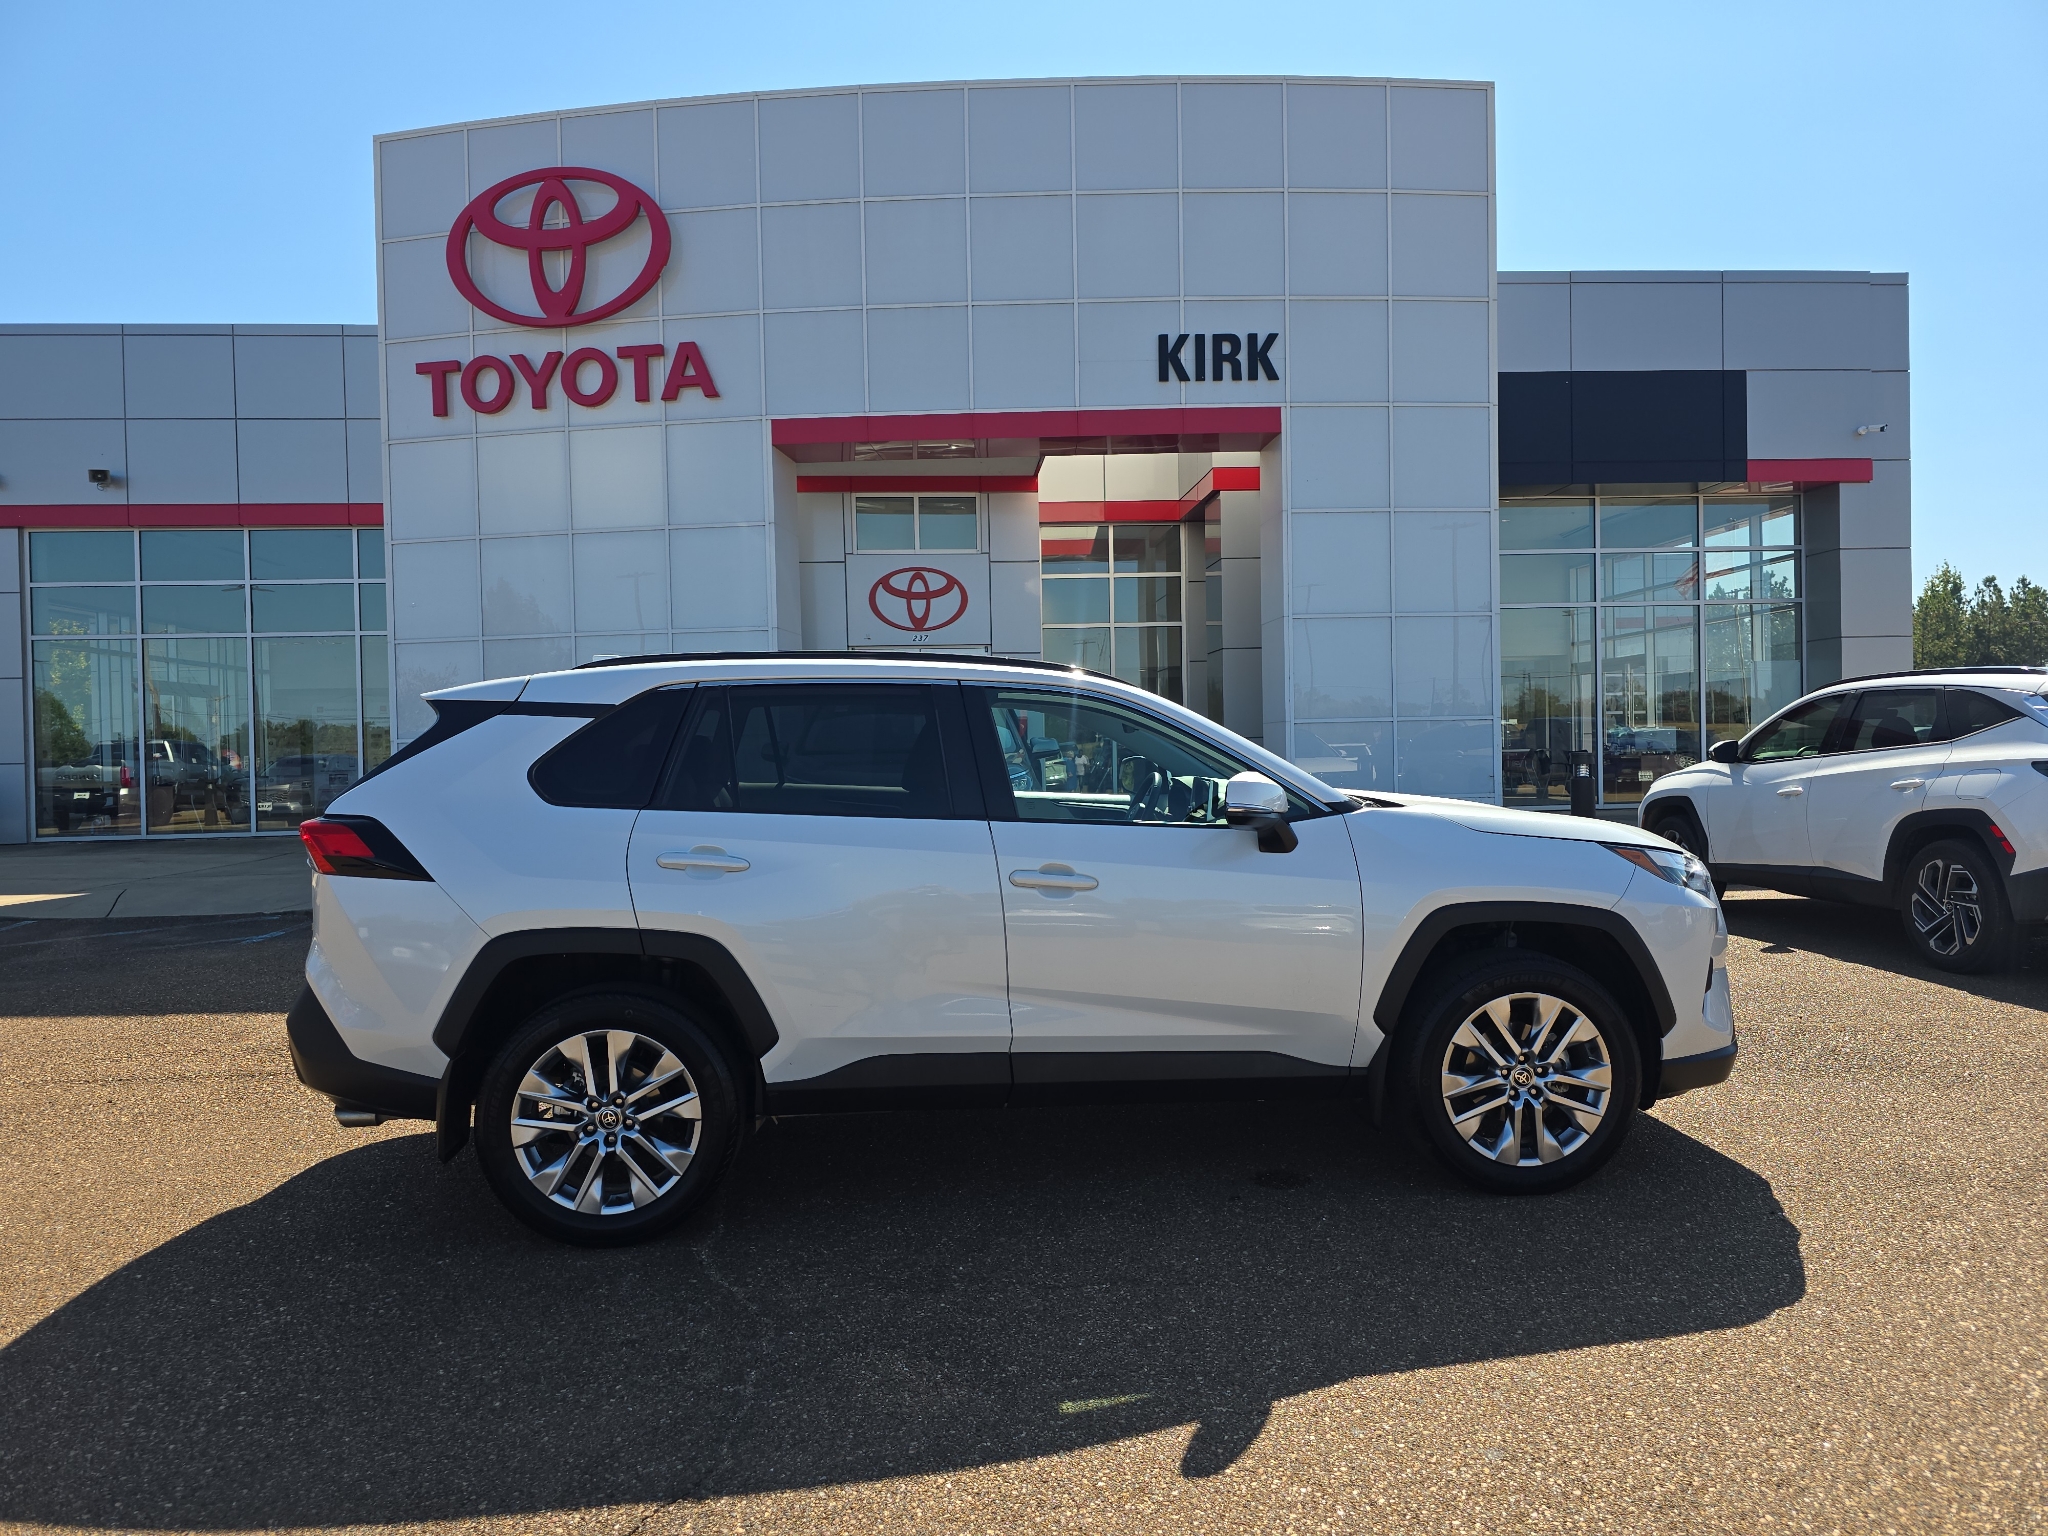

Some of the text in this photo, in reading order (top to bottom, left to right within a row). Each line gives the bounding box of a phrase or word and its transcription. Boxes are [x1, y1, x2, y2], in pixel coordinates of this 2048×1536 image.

[415, 341, 720, 417] TOYOTA
[1158, 333, 1279, 382] KIRK
[912, 634, 929, 642] 237
[1493, 974, 1562, 989] MICHELIN
[487, 1071, 509, 1147] MICHELIN
